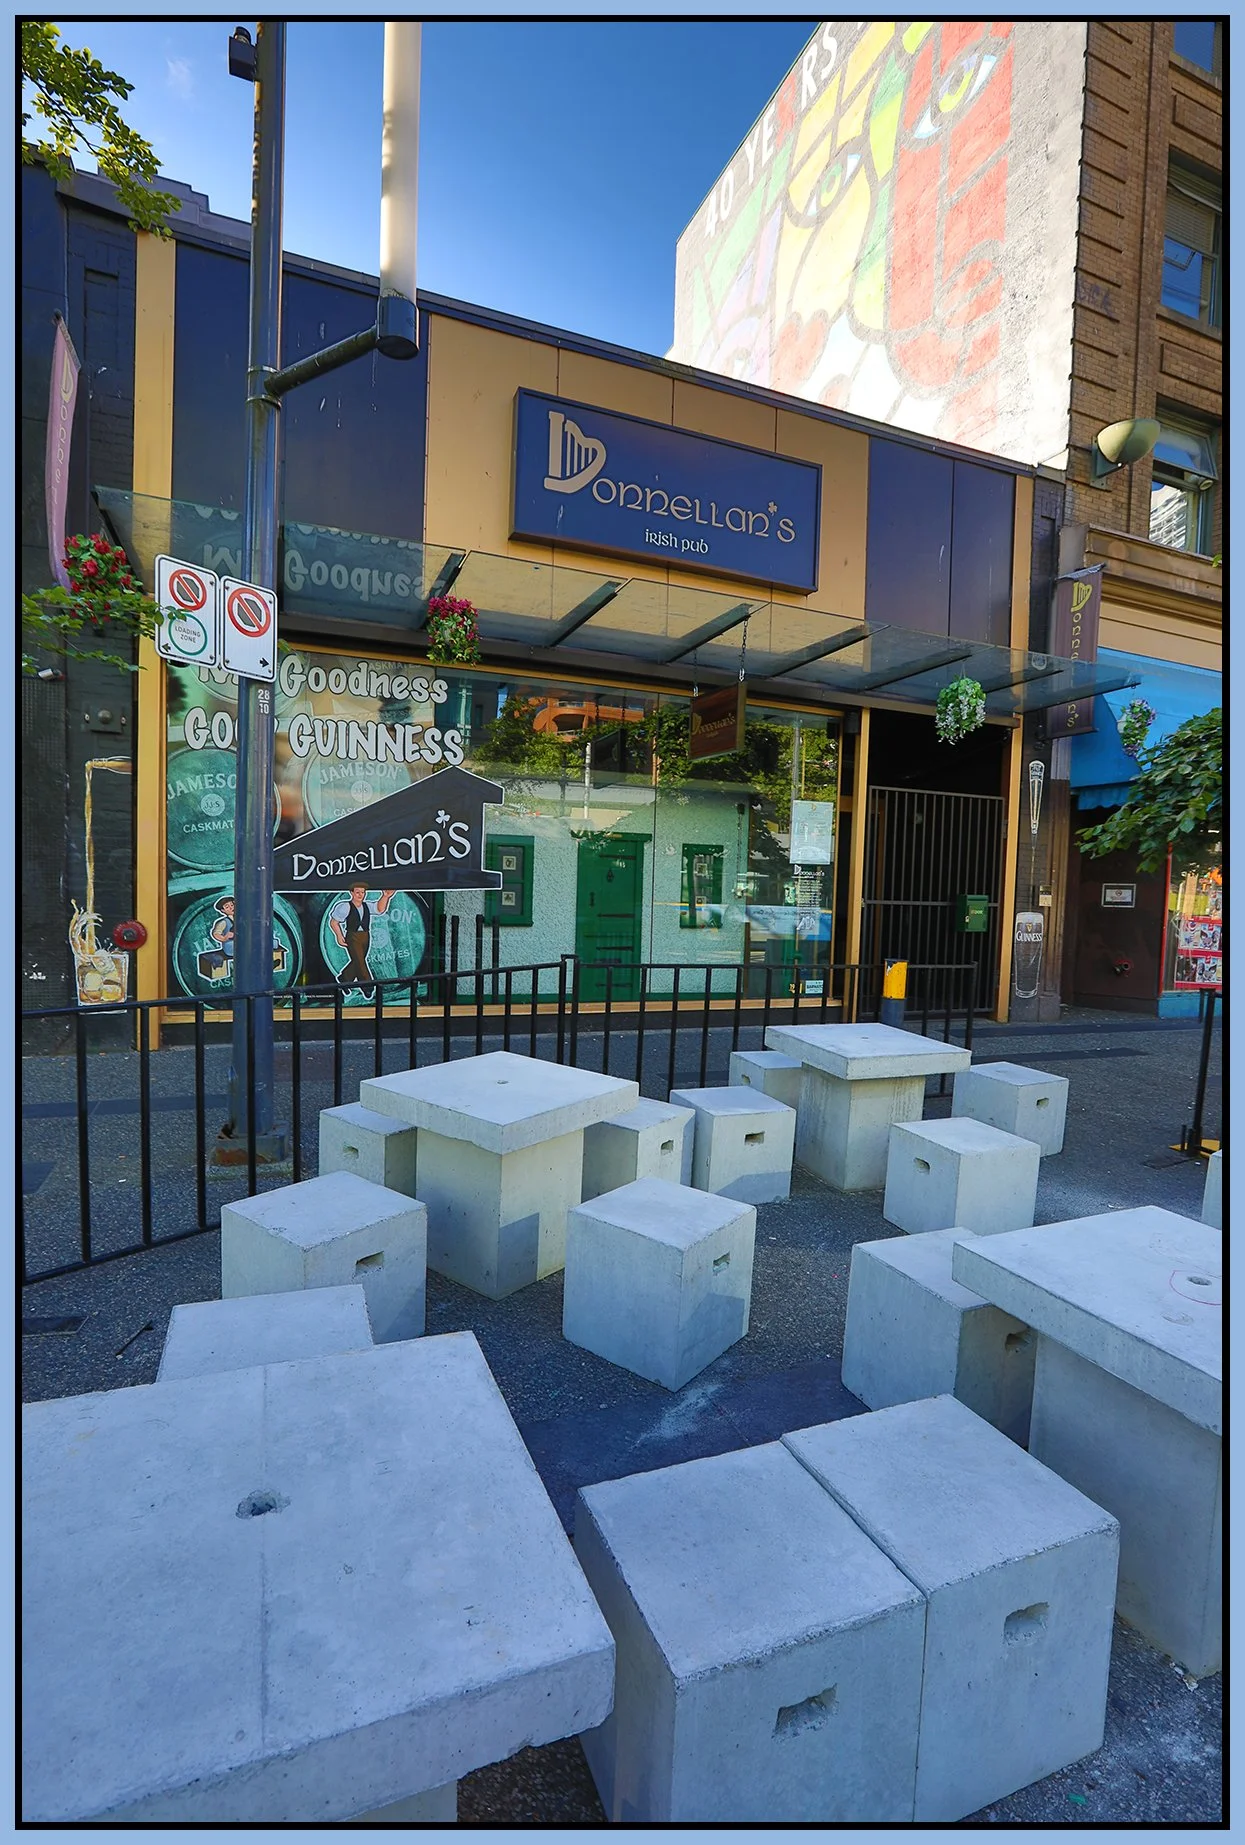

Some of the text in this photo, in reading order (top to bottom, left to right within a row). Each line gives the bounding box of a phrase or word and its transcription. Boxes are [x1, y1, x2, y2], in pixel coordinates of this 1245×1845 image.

[705, 168, 735, 238] 40
[681, 538, 709, 554] pub
[175, 625, 202, 638] LOADING
[180, 634, 197, 644] ZONE
[279, 654, 449, 703] Goodness
[258, 689, 271, 700] 28
[259, 703, 270, 714] 10
[289, 713, 464, 766] GUINNESS
[320, 761, 402, 785] JAMESON
[167, 773, 237, 800] JAMESO
[183, 819, 235, 834] CASKMAT
